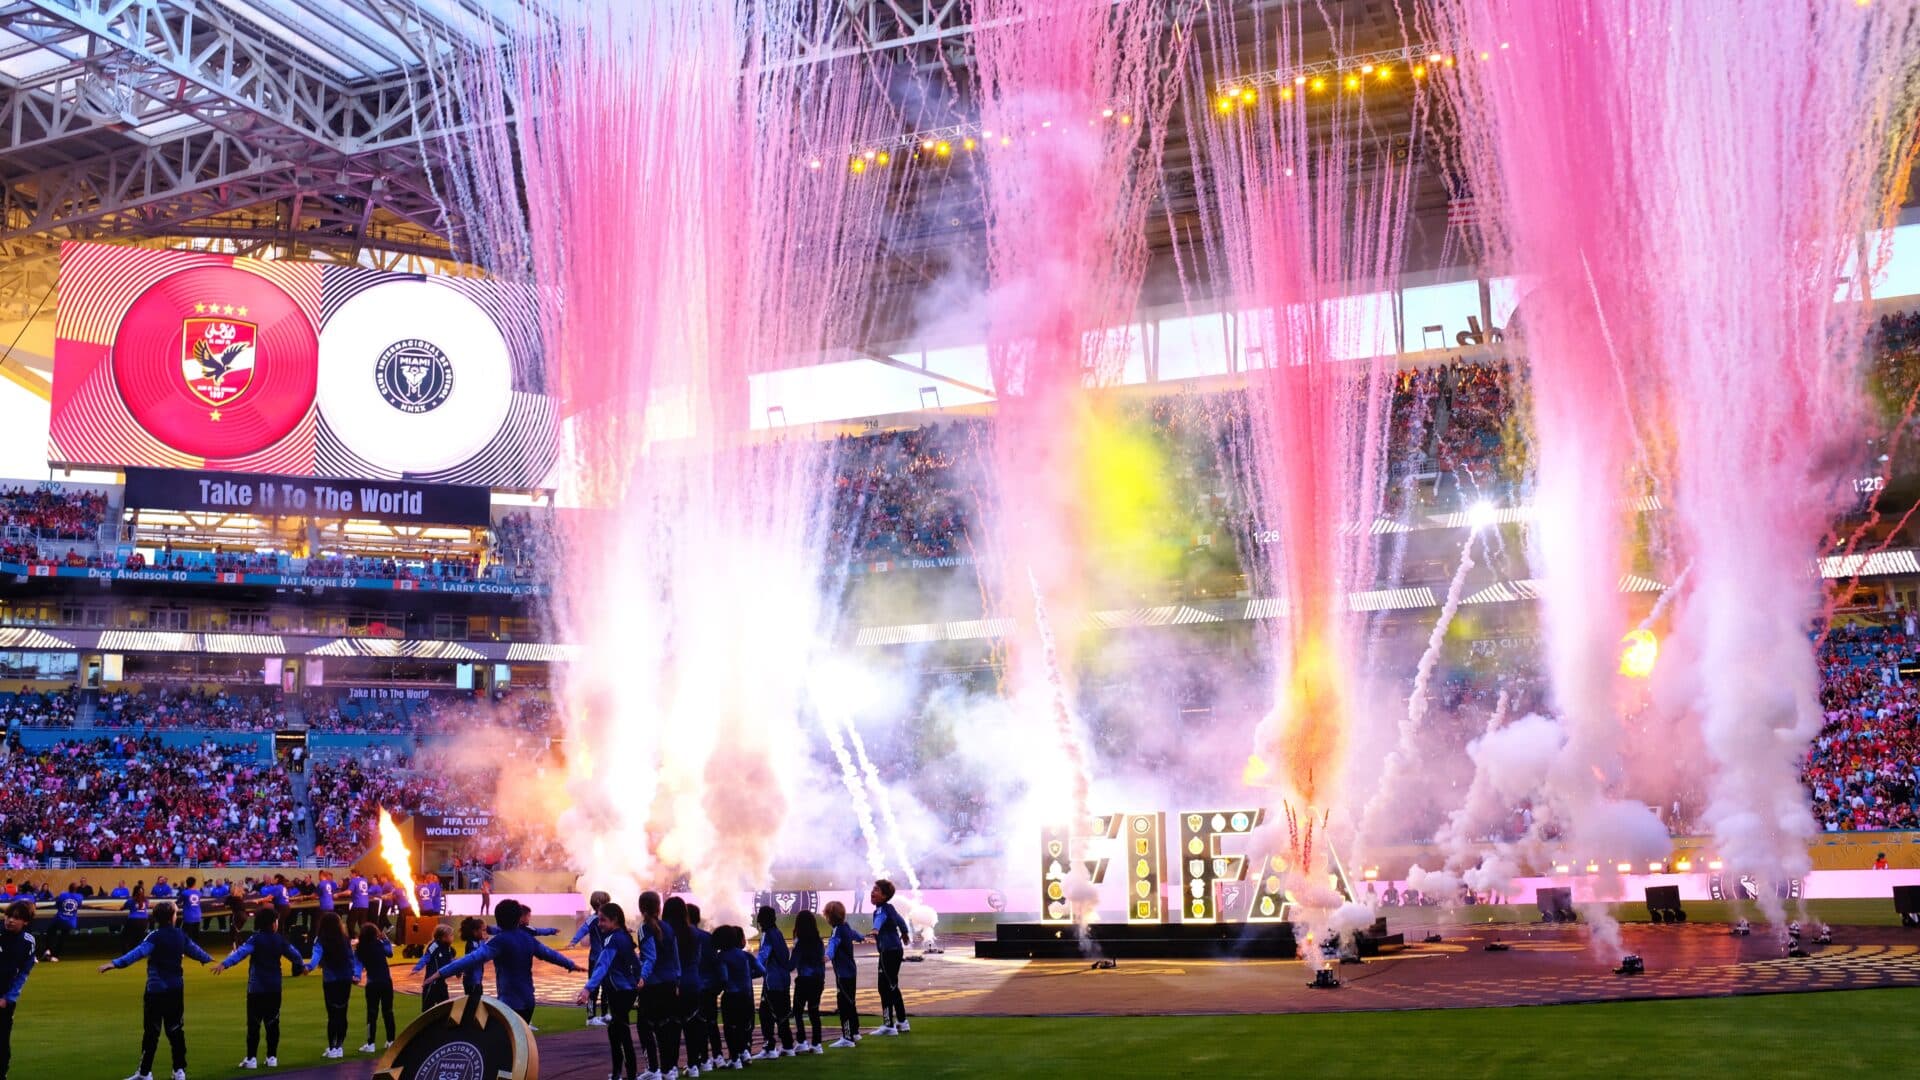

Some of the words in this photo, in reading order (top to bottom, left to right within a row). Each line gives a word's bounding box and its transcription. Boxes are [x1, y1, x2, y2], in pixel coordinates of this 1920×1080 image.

[378, 341, 440, 369] INTERNACIONAL
[400, 357, 430, 366] MIAMI
[440, 356, 449, 367] DE
[377, 373, 388, 395] CLUB
[863, 420, 879, 430] 314
[39, 481, 61, 492] 309
[199, 479, 252, 506] Take
[259, 482, 275, 508] It
[282, 484, 306, 509] To
[314, 486, 353, 512] The
[360, 488, 423, 515] World
[912, 559, 936, 568] PAUL
[88, 569, 112, 579] DICK
[117, 569, 169, 580] ANDERSON
[172, 571, 187, 581] 40
[301, 576, 337, 587] MOORE
[341, 578, 356, 588] 89
[443, 583, 475, 593] LARRY
[525, 585, 539, 594] 39
[350, 688, 368, 698] Take
[371, 689, 377, 698] It
[379, 689, 388, 698] To
[390, 689, 404, 698] The
[406, 690, 429, 699] World
[426, 827, 460, 836] WORLD
[421, 1047, 475, 1077] INTERNACIONAL
